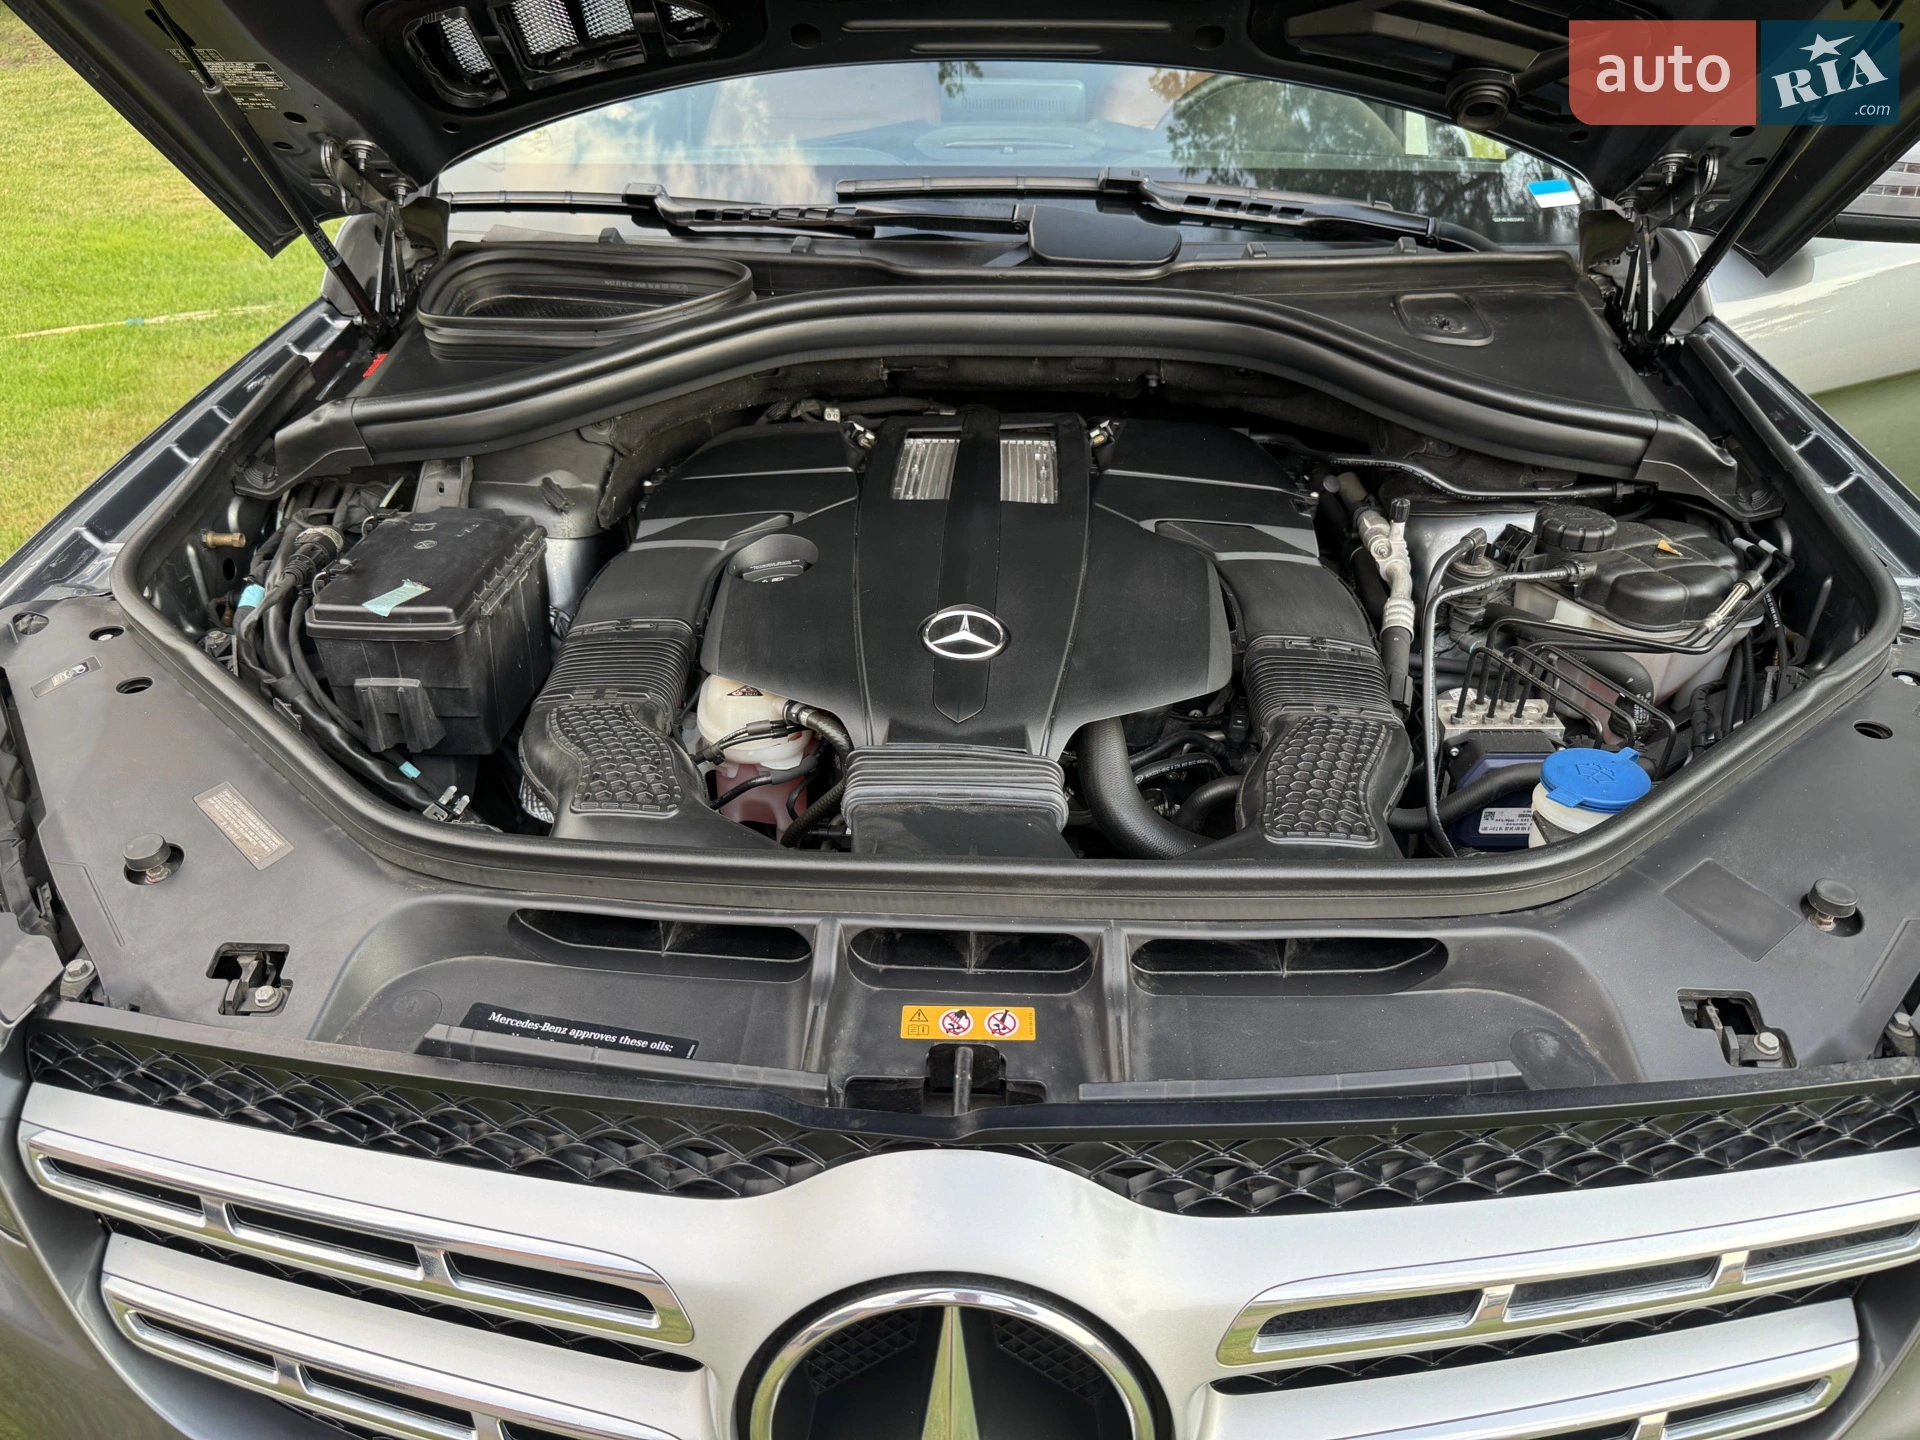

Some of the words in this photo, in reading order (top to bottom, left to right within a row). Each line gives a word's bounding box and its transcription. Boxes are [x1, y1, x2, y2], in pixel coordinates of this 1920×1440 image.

[488, 1011, 567, 1035] Mercedes-Benz
[569, 1027, 617, 1044] approves
[619, 1035, 649, 1049] these
[650, 1040, 674, 1053] oils:
